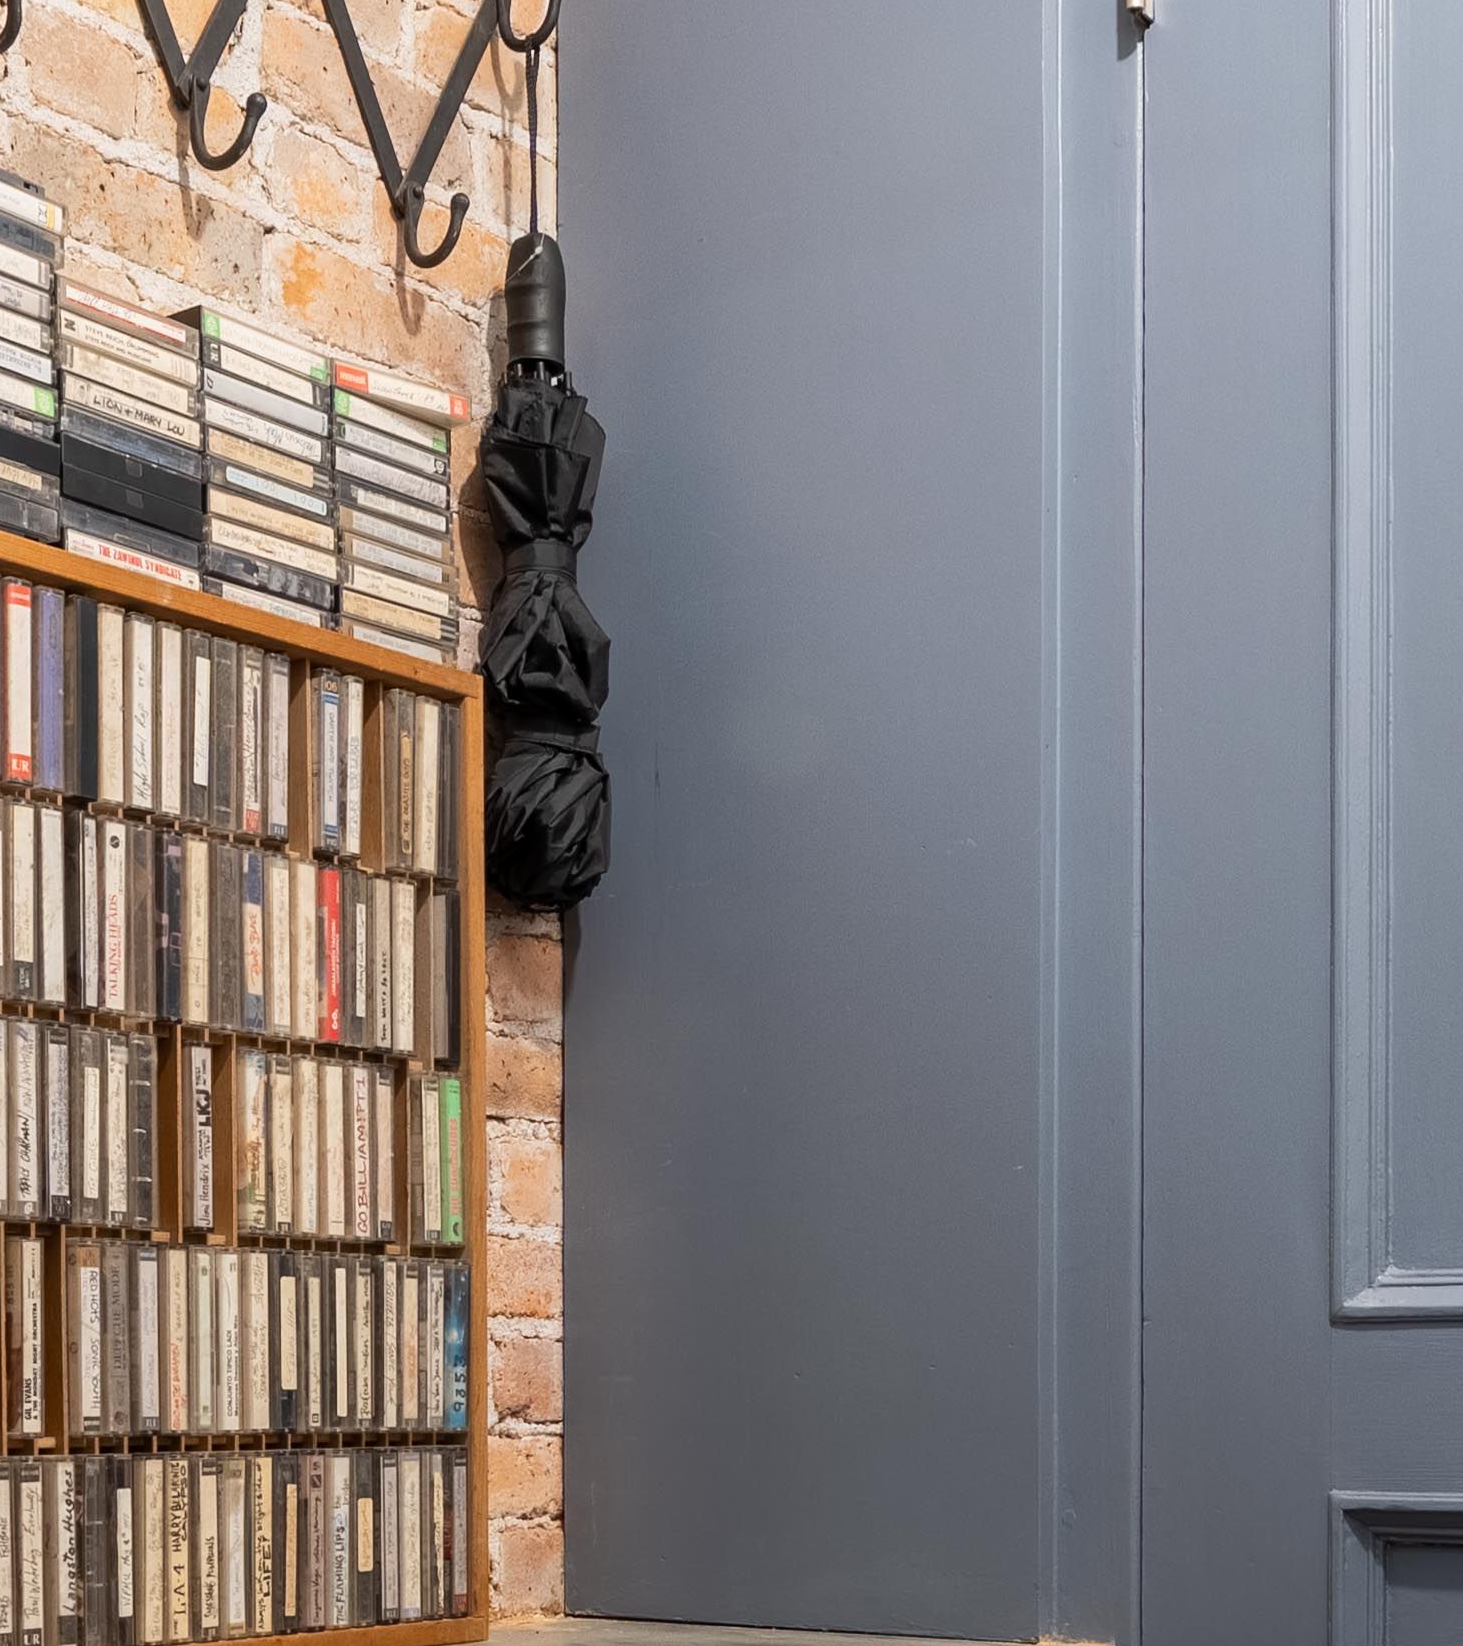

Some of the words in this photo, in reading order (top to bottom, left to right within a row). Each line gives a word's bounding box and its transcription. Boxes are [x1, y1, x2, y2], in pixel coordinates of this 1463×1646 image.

[92, 394, 124, 413] LION
[133, 407, 163, 427] MARY
[166, 420, 186, 436] LOU
[96, 544, 113, 557] THE
[144, 560, 184, 580] SYNDICATE
[133, 773, 151, 800] High
[107, 893, 119, 939] HEADS
[107, 942, 119, 998] TALKING
[195, 1089, 212, 1127] LKJ
[198, 1163, 210, 1201] Hendrix
[357, 1211, 368, 1233] GO
[110, 1266, 121, 1306] MODE
[110, 1308, 123, 1370] DEPECHE
[226, 1349, 234, 1374] TIPICO
[23, 1377, 32, 1405] EVANS
[226, 1375, 234, 1417] CONJUNTO
[24, 1406, 32, 1421] GIL
[59, 1469, 78, 1534] Hughes
[180, 1464, 188, 1542] CALYPSO
[170, 1512, 182, 1553] HARRY
[334, 1525, 346, 1551] LIPS
[59, 1536, 78, 1614] Langston
[334, 1555, 346, 1604] FLAMING
[336, 1604, 345, 1624] THE
